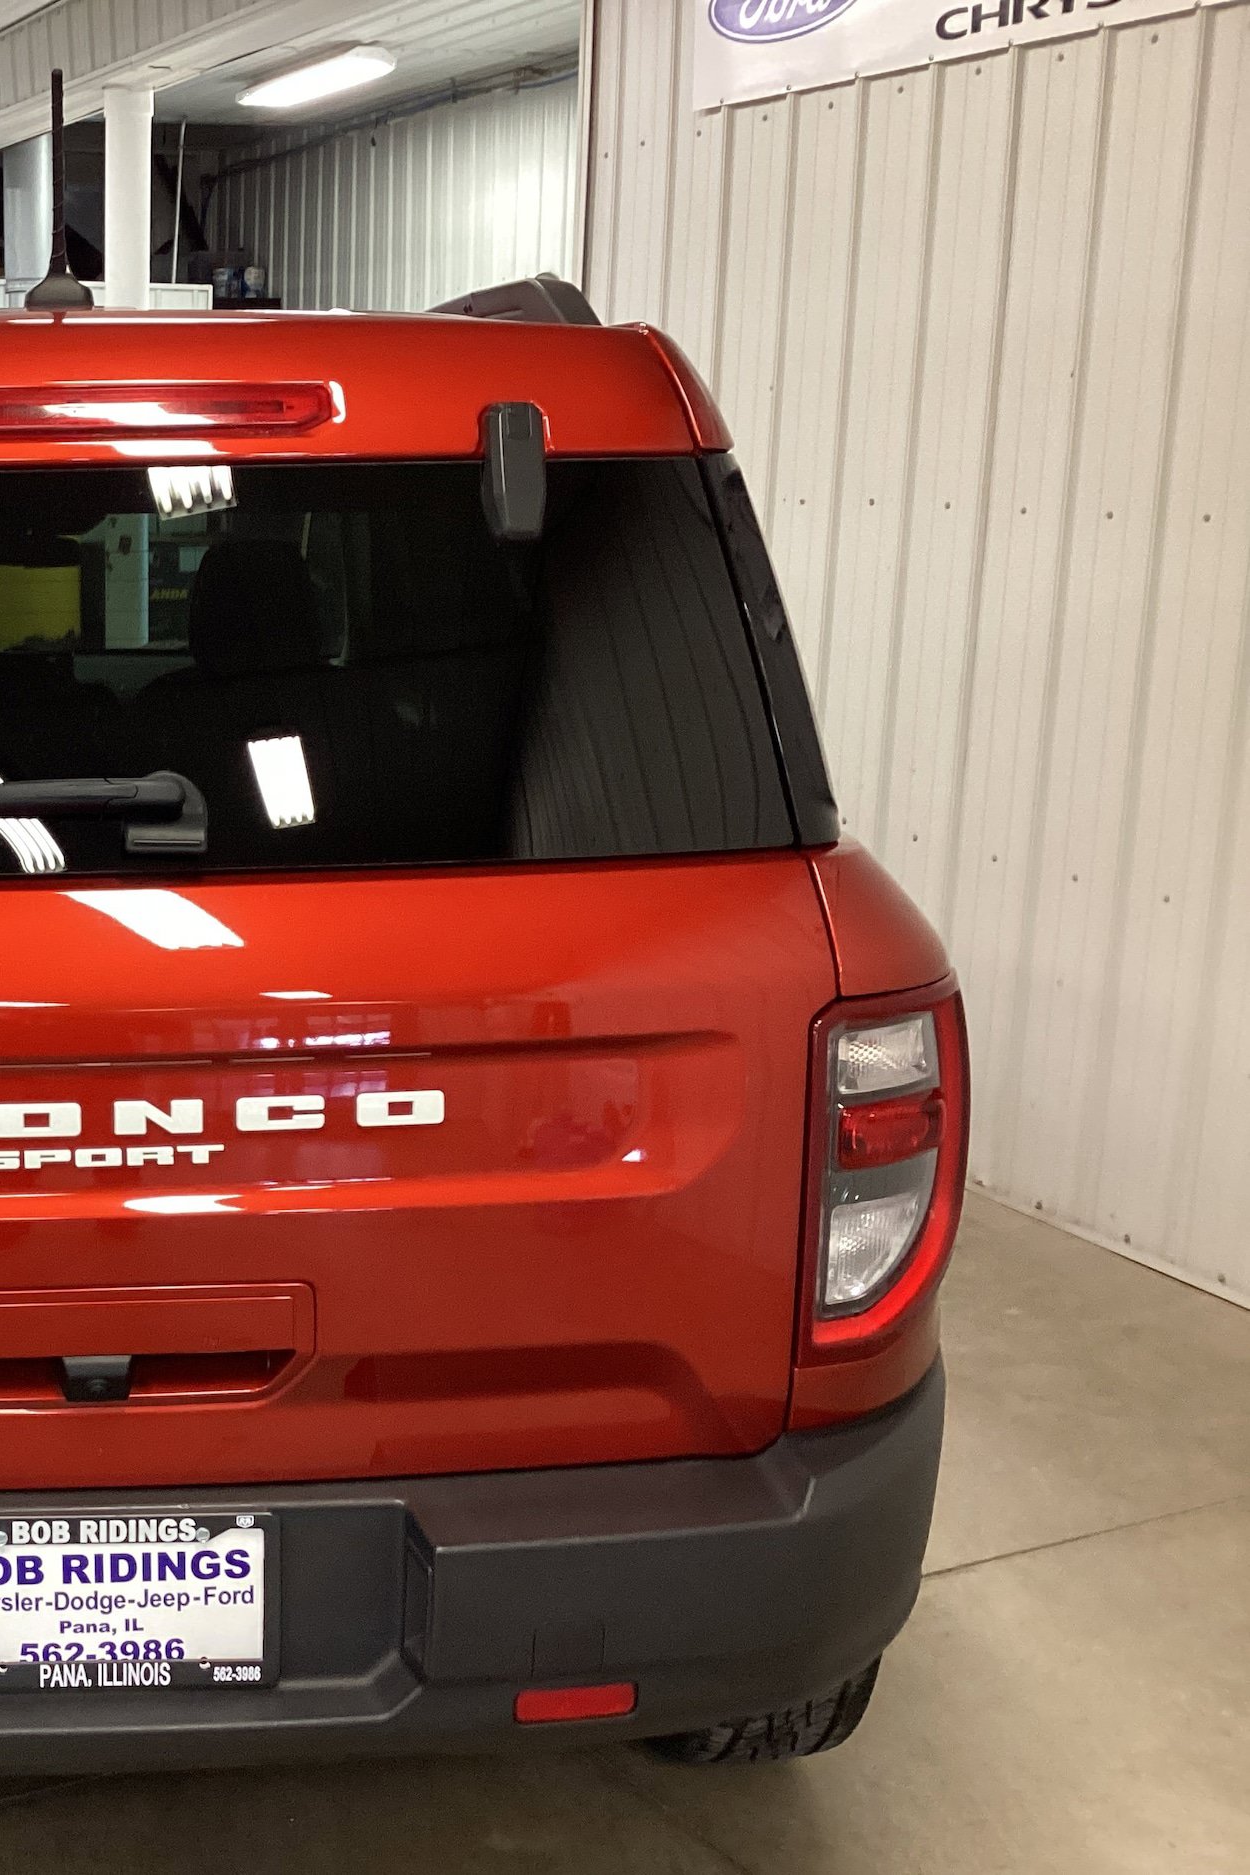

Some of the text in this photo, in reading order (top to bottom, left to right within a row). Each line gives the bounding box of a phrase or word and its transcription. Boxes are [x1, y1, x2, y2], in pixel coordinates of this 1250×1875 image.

[11, 1518, 197, 1544] BOB RIDINGS
[61, 1549, 251, 1584] RIDINGS
[59, 1618, 144, 1635] Pana, IL
[19, 1638, 185, 1662] 562-3986
[39, 1662, 172, 1688] PANA, ILLINOIS
[212, 1665, 262, 1682] 562-3986
